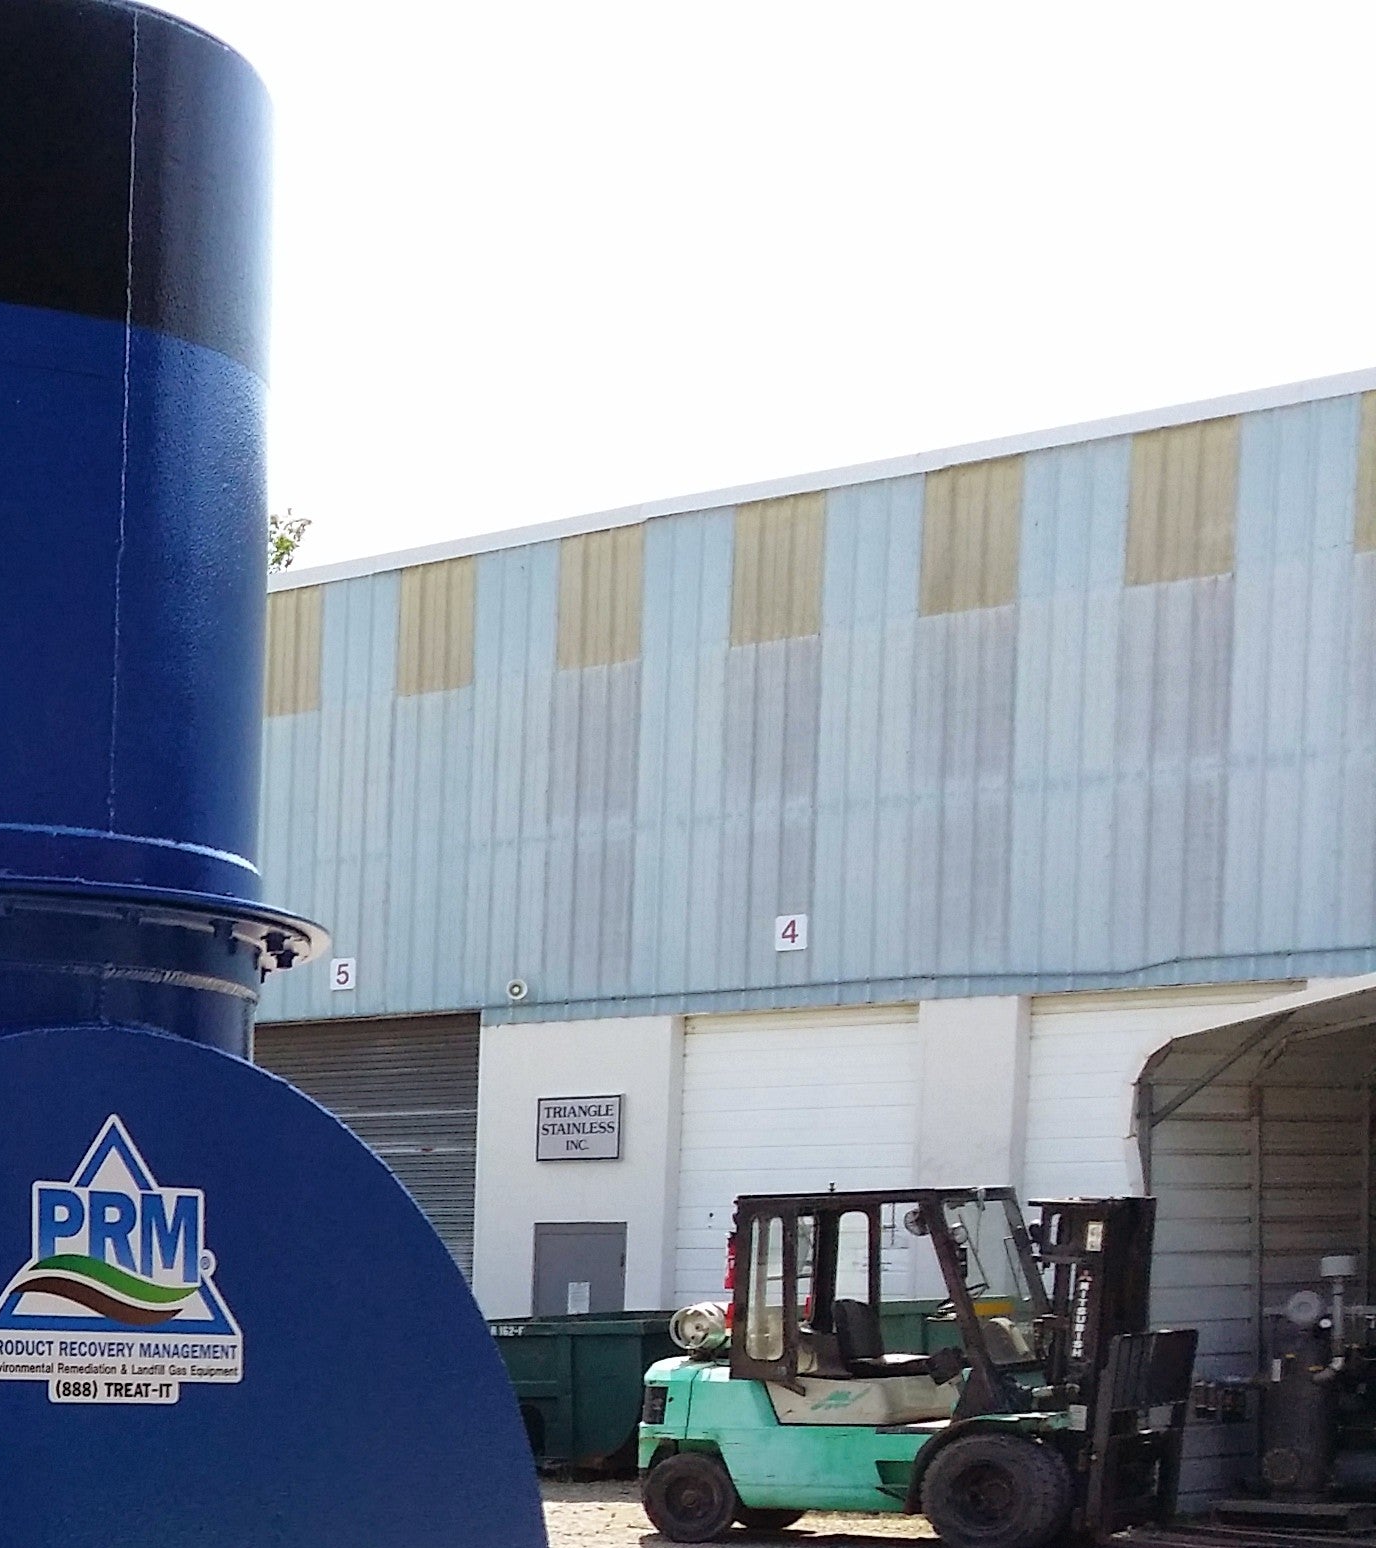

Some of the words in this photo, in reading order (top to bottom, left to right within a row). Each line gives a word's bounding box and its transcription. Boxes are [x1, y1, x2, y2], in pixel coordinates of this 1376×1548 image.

[781, 919, 799, 944] 4
[336, 963, 350, 985] 5
[544, 1104, 614, 1119] TRIANGLE
[541, 1121, 615, 1136] STAINLESS
[38, 1188, 199, 1284] PRM
[58, 1341, 135, 1358] RECOVERY
[139, 1343, 238, 1360] MANAGEMENT
[57, 1362, 117, 1376] Remediation
[120, 1364, 127, 1375] &
[131, 1364, 165, 1376] Landfill
[168, 1364, 187, 1376] Gas
[190, 1365, 238, 1379] Equipment
[55, 1380, 98, 1399] (888)
[104, 1382, 173, 1399] TREAT-IT
